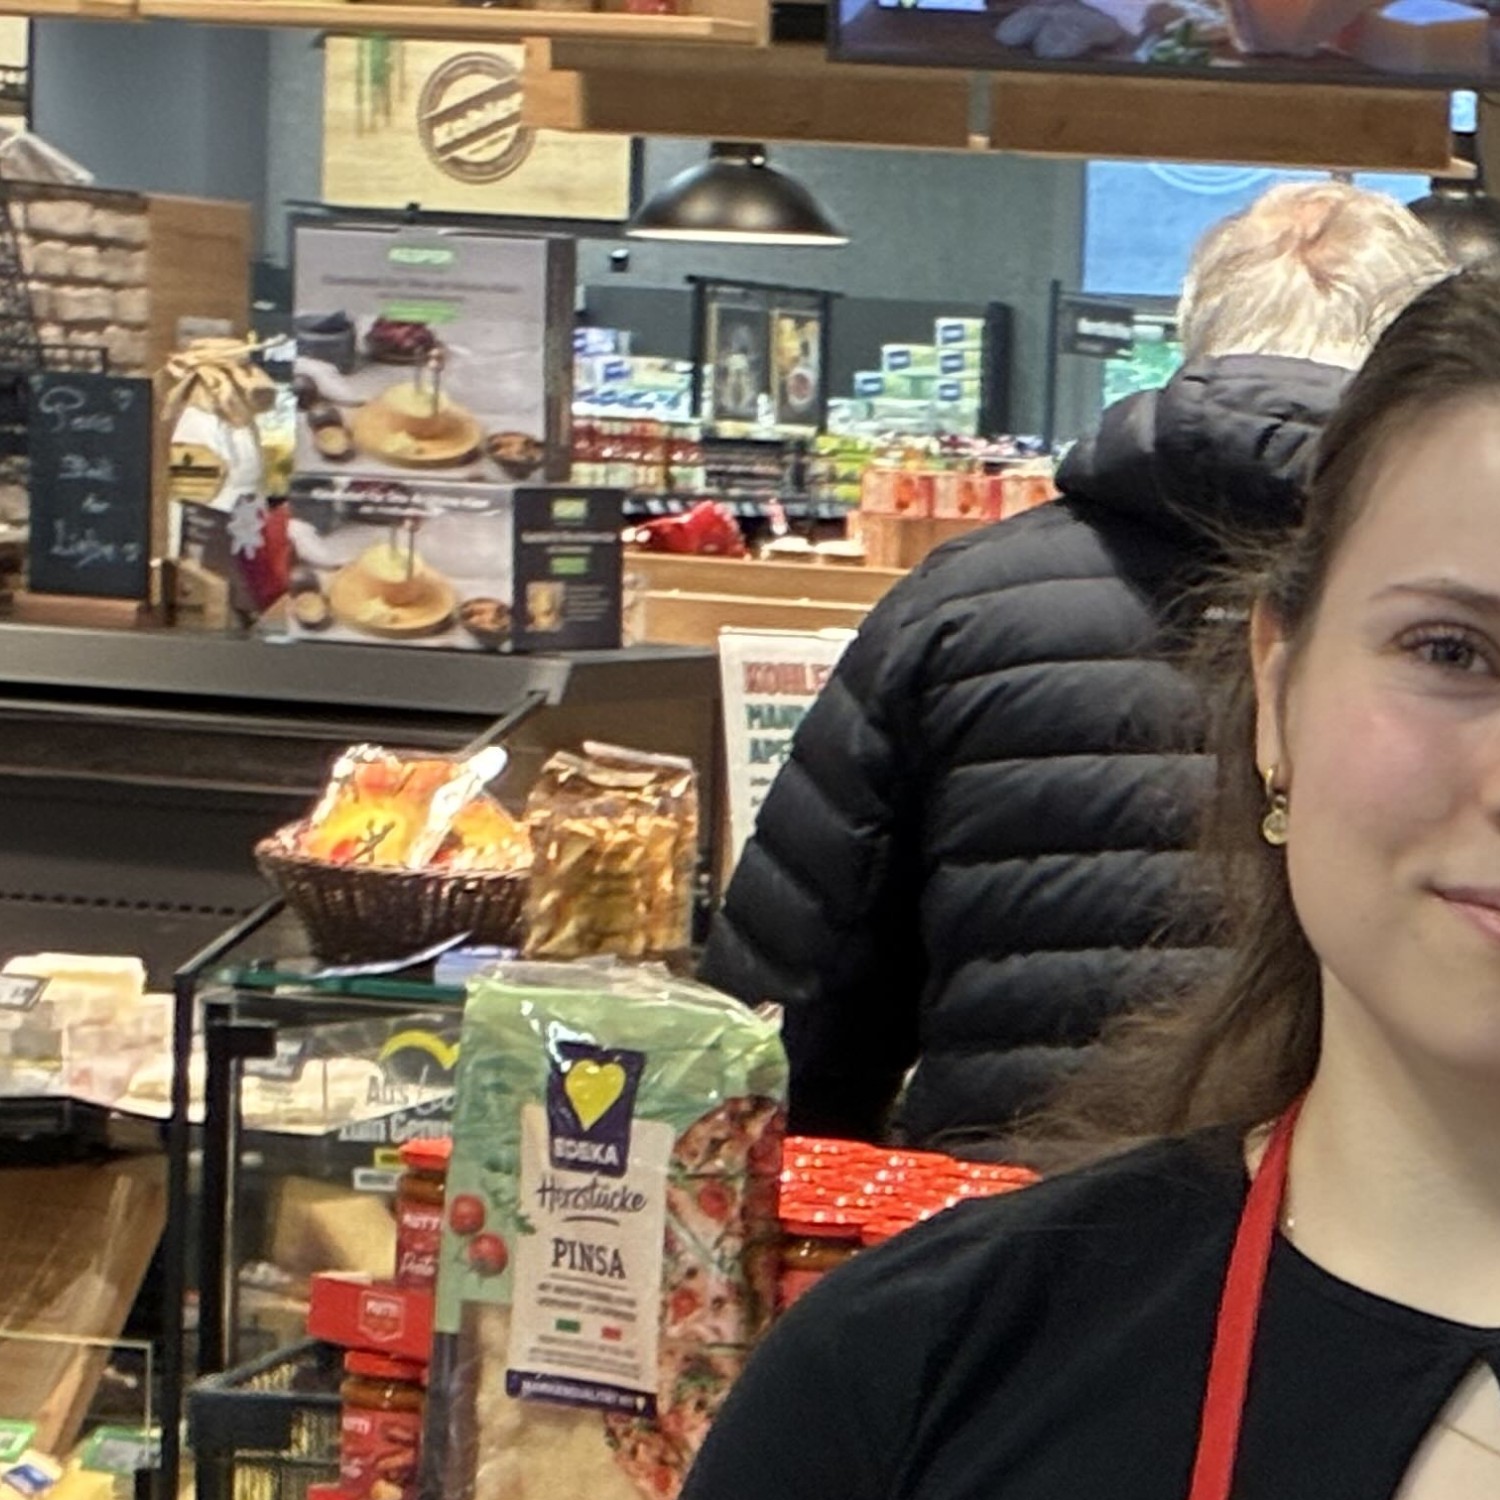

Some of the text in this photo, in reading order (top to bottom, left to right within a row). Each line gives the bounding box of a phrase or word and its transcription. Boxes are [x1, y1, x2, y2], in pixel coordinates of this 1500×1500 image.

[552, 1137, 620, 1167] EDEKA
[536, 1172, 648, 1214] Herzstücke
[551, 1237, 627, 1280] PINSA
